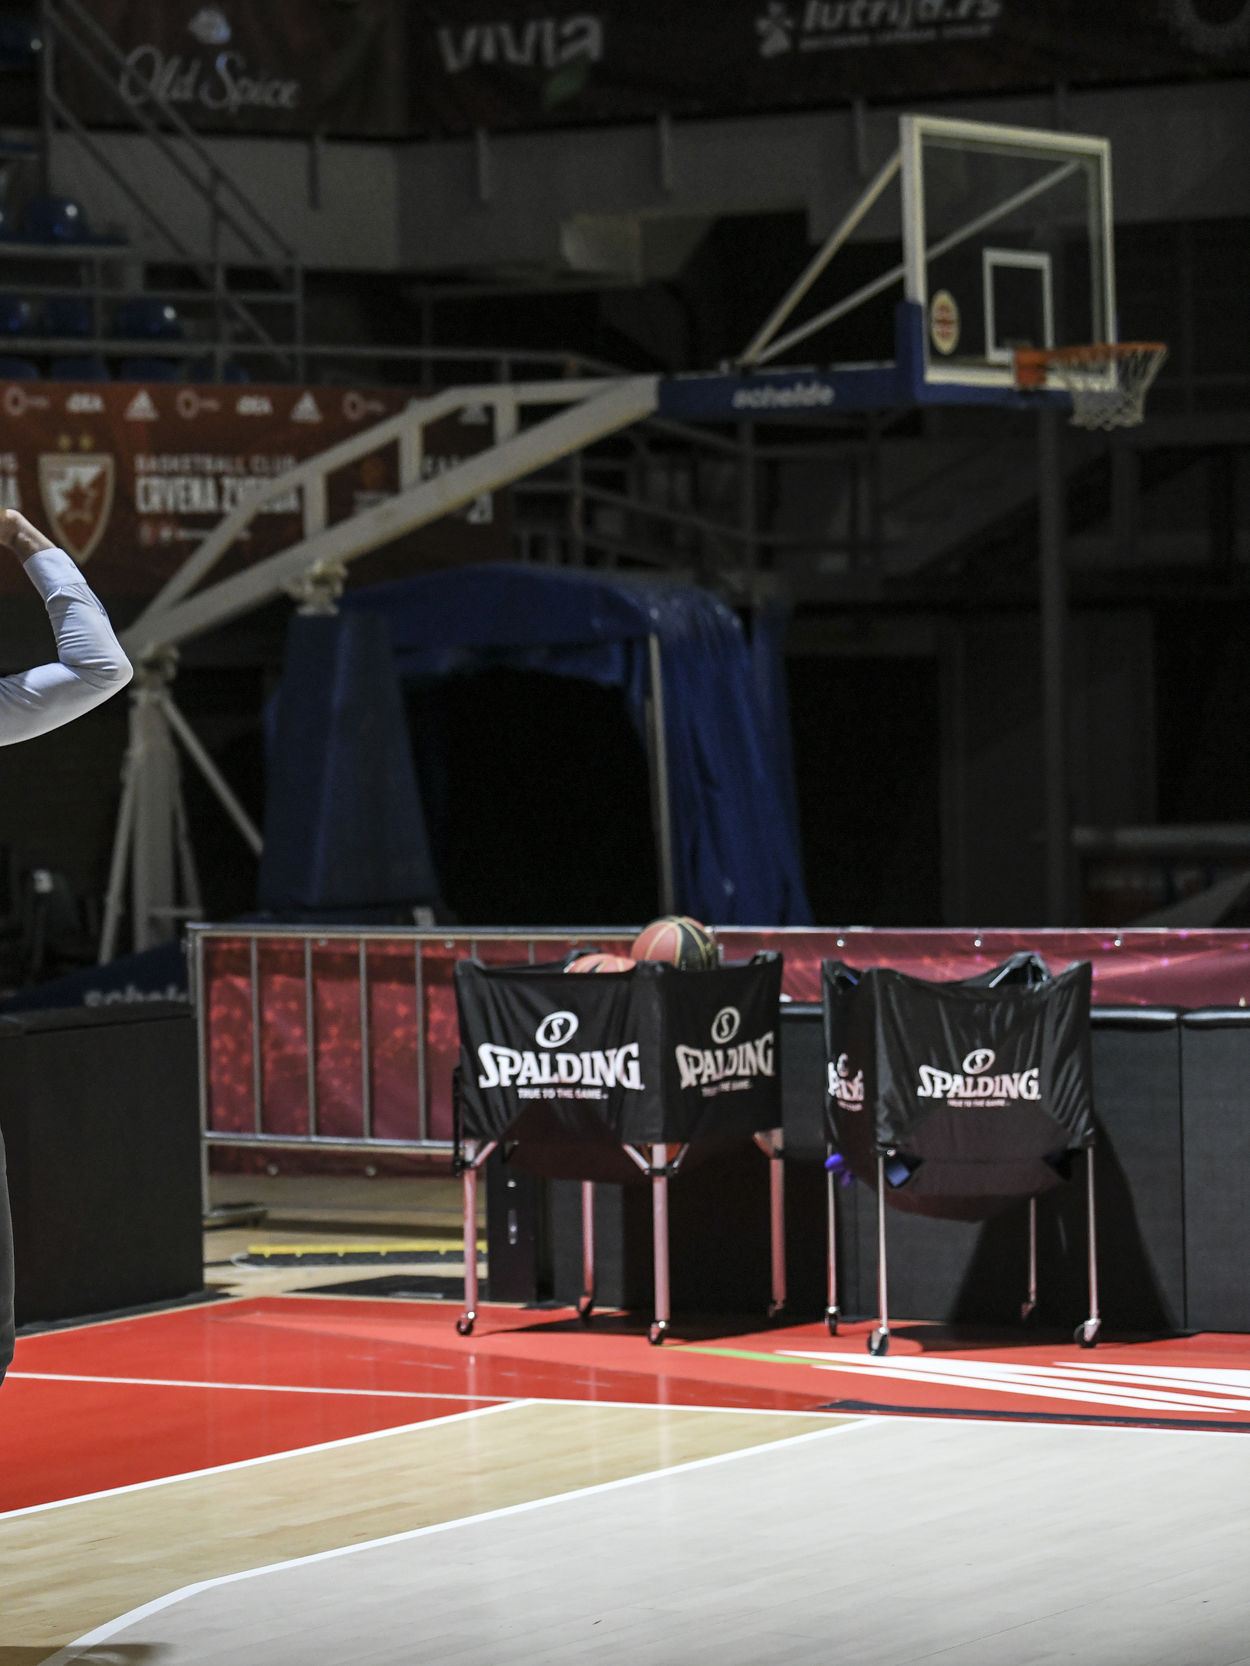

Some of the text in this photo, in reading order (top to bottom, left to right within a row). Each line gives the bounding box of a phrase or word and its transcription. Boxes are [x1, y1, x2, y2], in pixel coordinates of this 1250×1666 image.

[120, 44, 299, 114] Old Spice
[477, 1042, 638, 1090] SPALDING
[675, 1031, 775, 1090] SPALDING
[916, 1064, 1038, 1100] SPALDING
